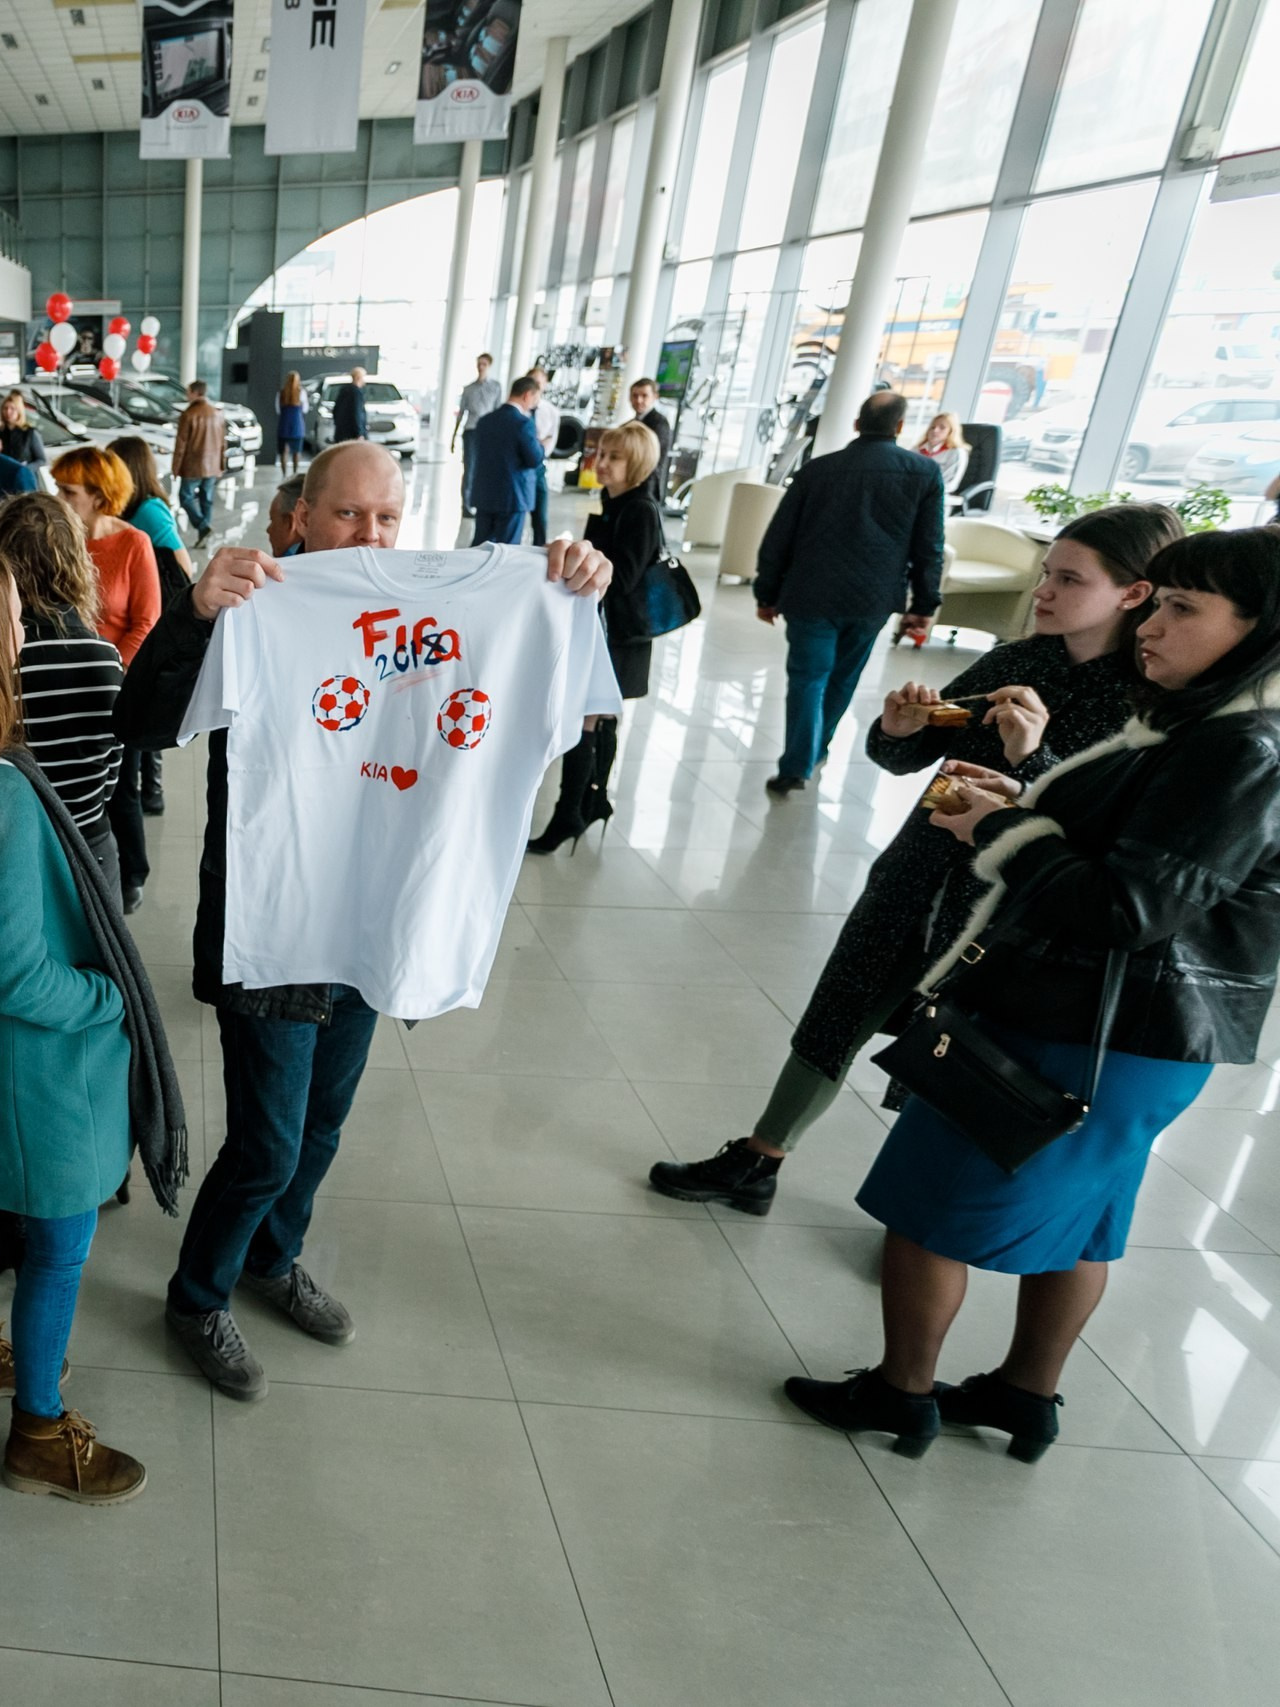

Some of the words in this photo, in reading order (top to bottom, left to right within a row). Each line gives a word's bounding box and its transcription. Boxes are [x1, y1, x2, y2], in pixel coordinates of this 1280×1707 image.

[453, 88, 477, 99] KIA
[176, 109, 198, 120] KIA
[375, 633, 448, 681] 2018
[360, 761, 388, 782] KIA
